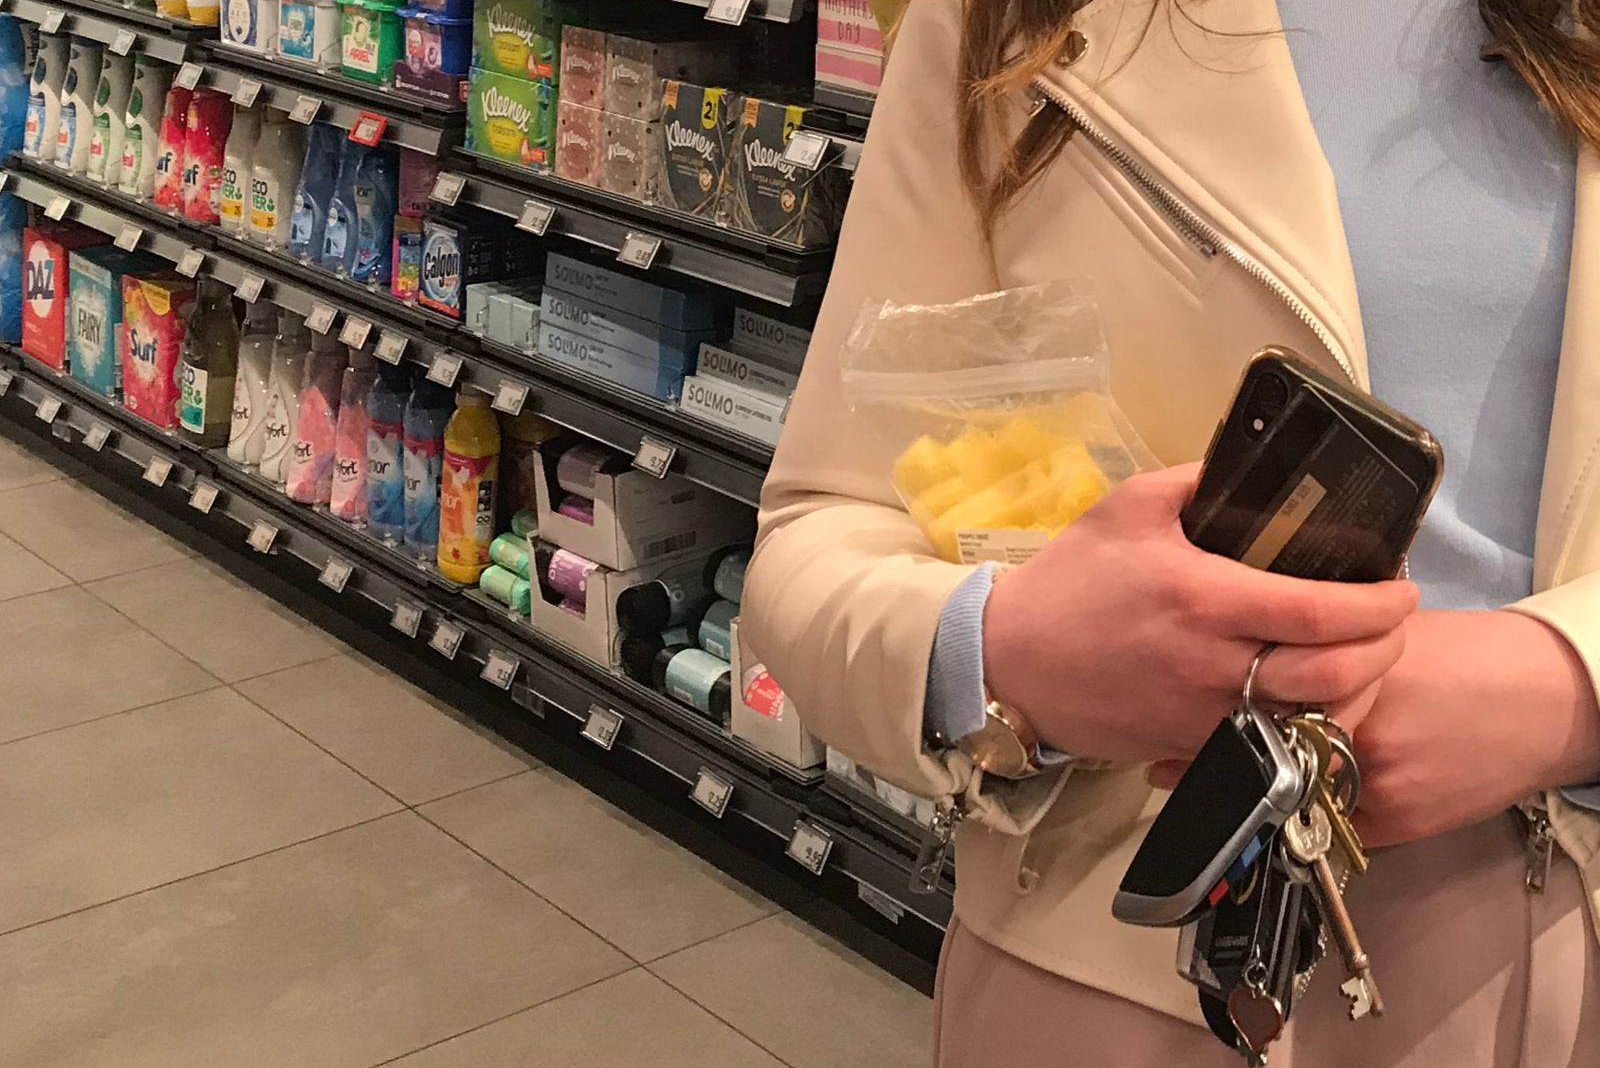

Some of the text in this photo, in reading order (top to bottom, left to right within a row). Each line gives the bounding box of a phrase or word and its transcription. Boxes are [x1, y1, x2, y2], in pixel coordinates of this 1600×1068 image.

[486, 3, 535, 48] Kleenex
[480, 87, 533, 133] Kleenex
[664, 119, 717, 162] Kleenex
[25, 259, 56, 301] DAZ
[422, 248, 461, 290] Calgon
[77, 306, 102, 346] FAIRY
[548, 298, 589, 328] SOLIMO
[738, 314, 785, 345] SOLIMO
[128, 328, 159, 367] Surf
[547, 332, 588, 362] SOLIMO
[702, 350, 749, 380] SOLIMO
[687, 383, 734, 415] SOLIMO
